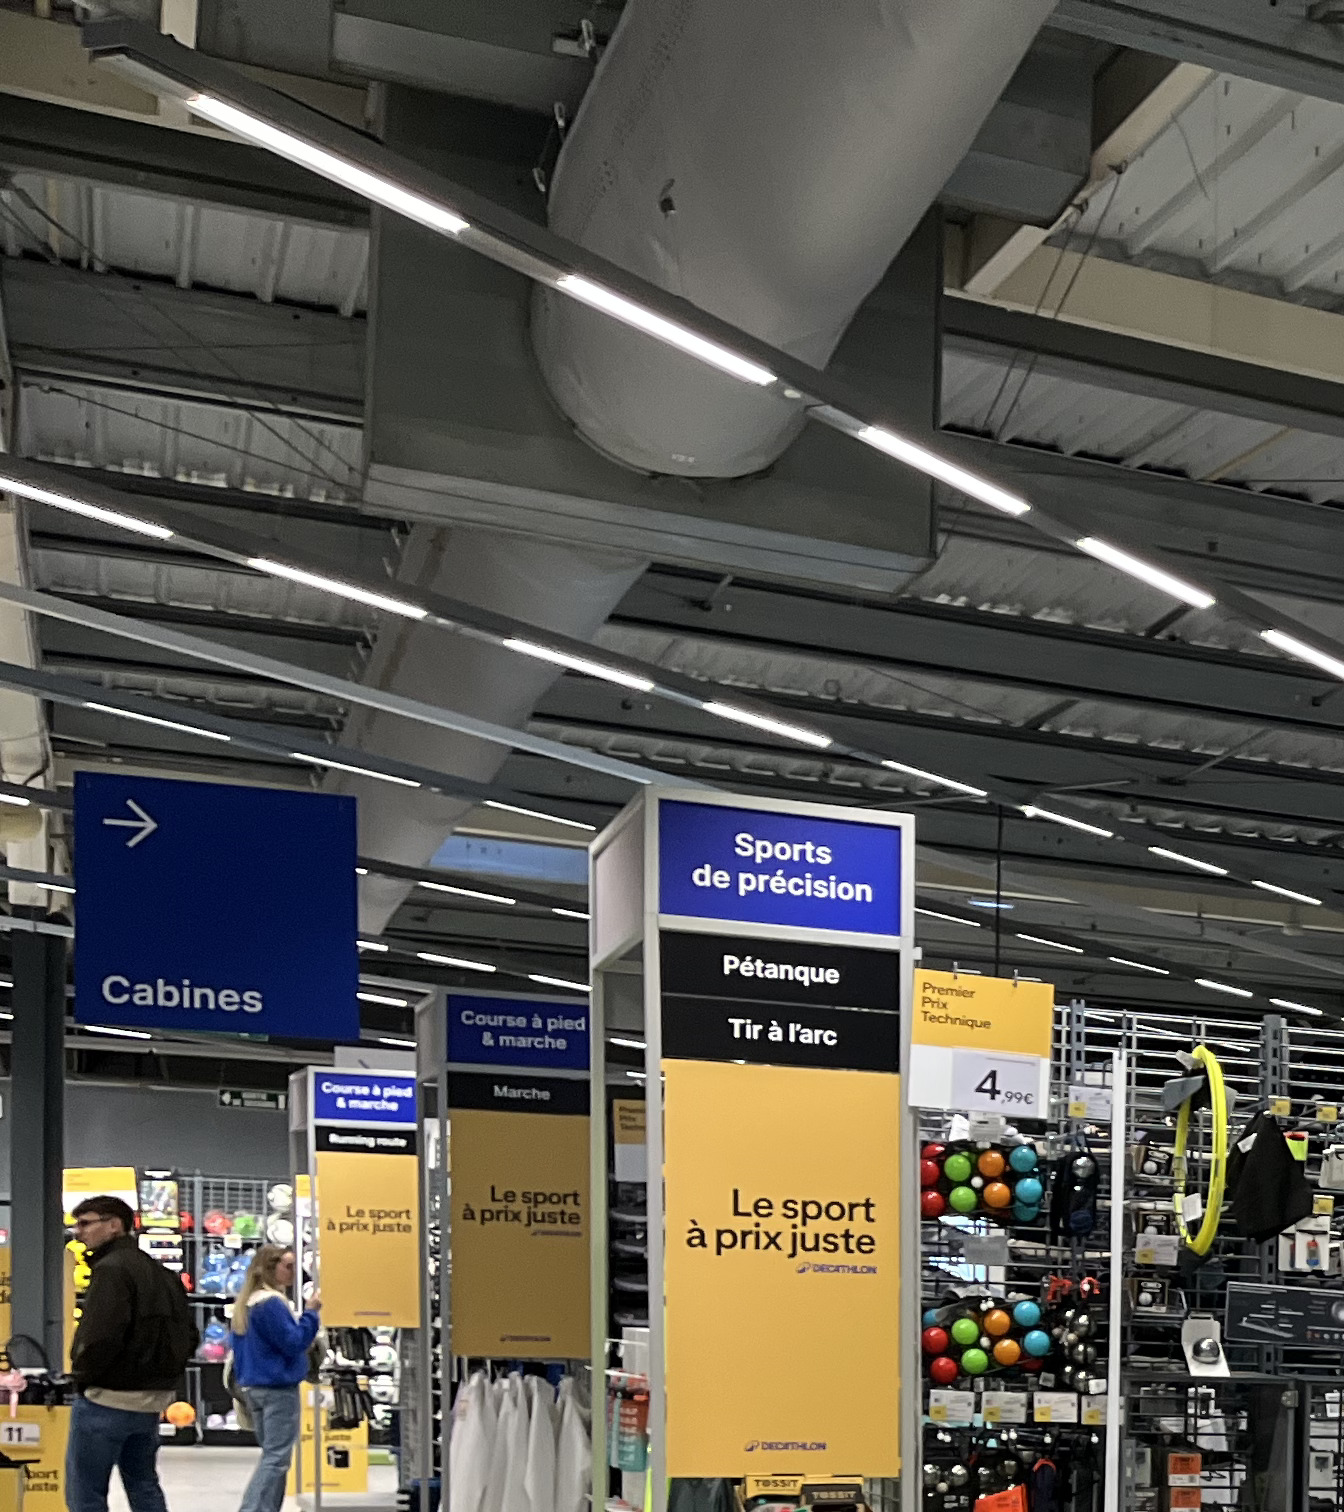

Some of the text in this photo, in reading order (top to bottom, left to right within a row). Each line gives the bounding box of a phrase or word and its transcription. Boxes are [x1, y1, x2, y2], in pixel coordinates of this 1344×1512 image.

[734, 832, 832, 866] Sports
[691, 863, 873, 903] de précision
[722, 954, 840, 987] Pétanque
[102, 973, 263, 1014] Cabines
[922, 982, 976, 998] Premier
[921, 996, 948, 1009] Prix
[460, 1010, 586, 1032] Course à pied
[921, 1010, 992, 1029] Technique
[728, 1017, 763, 1042] Tir
[767, 1018, 784, 1043] à
[481, 1032, 567, 1050] & marche
[321, 1081, 369, 1097] Course
[383, 1086, 413, 1099] pied
[493, 1084, 551, 1101] Marche
[348, 1099, 399, 1112] marche
[490, 1184, 581, 1207] Le sport
[346, 1205, 411, 1222] Le sport
[462, 1203, 582, 1227] à prix juste
[732, 1188, 876, 1230] Le sport
[327, 1217, 412, 1235] à prix juste
[686, 1220, 876, 1259] à prix juste
[812, 1263, 877, 1274] DECATHLON
[761, 1440, 827, 1451] DECATHLON
[754, 1479, 799, 1488] TOSSIT
